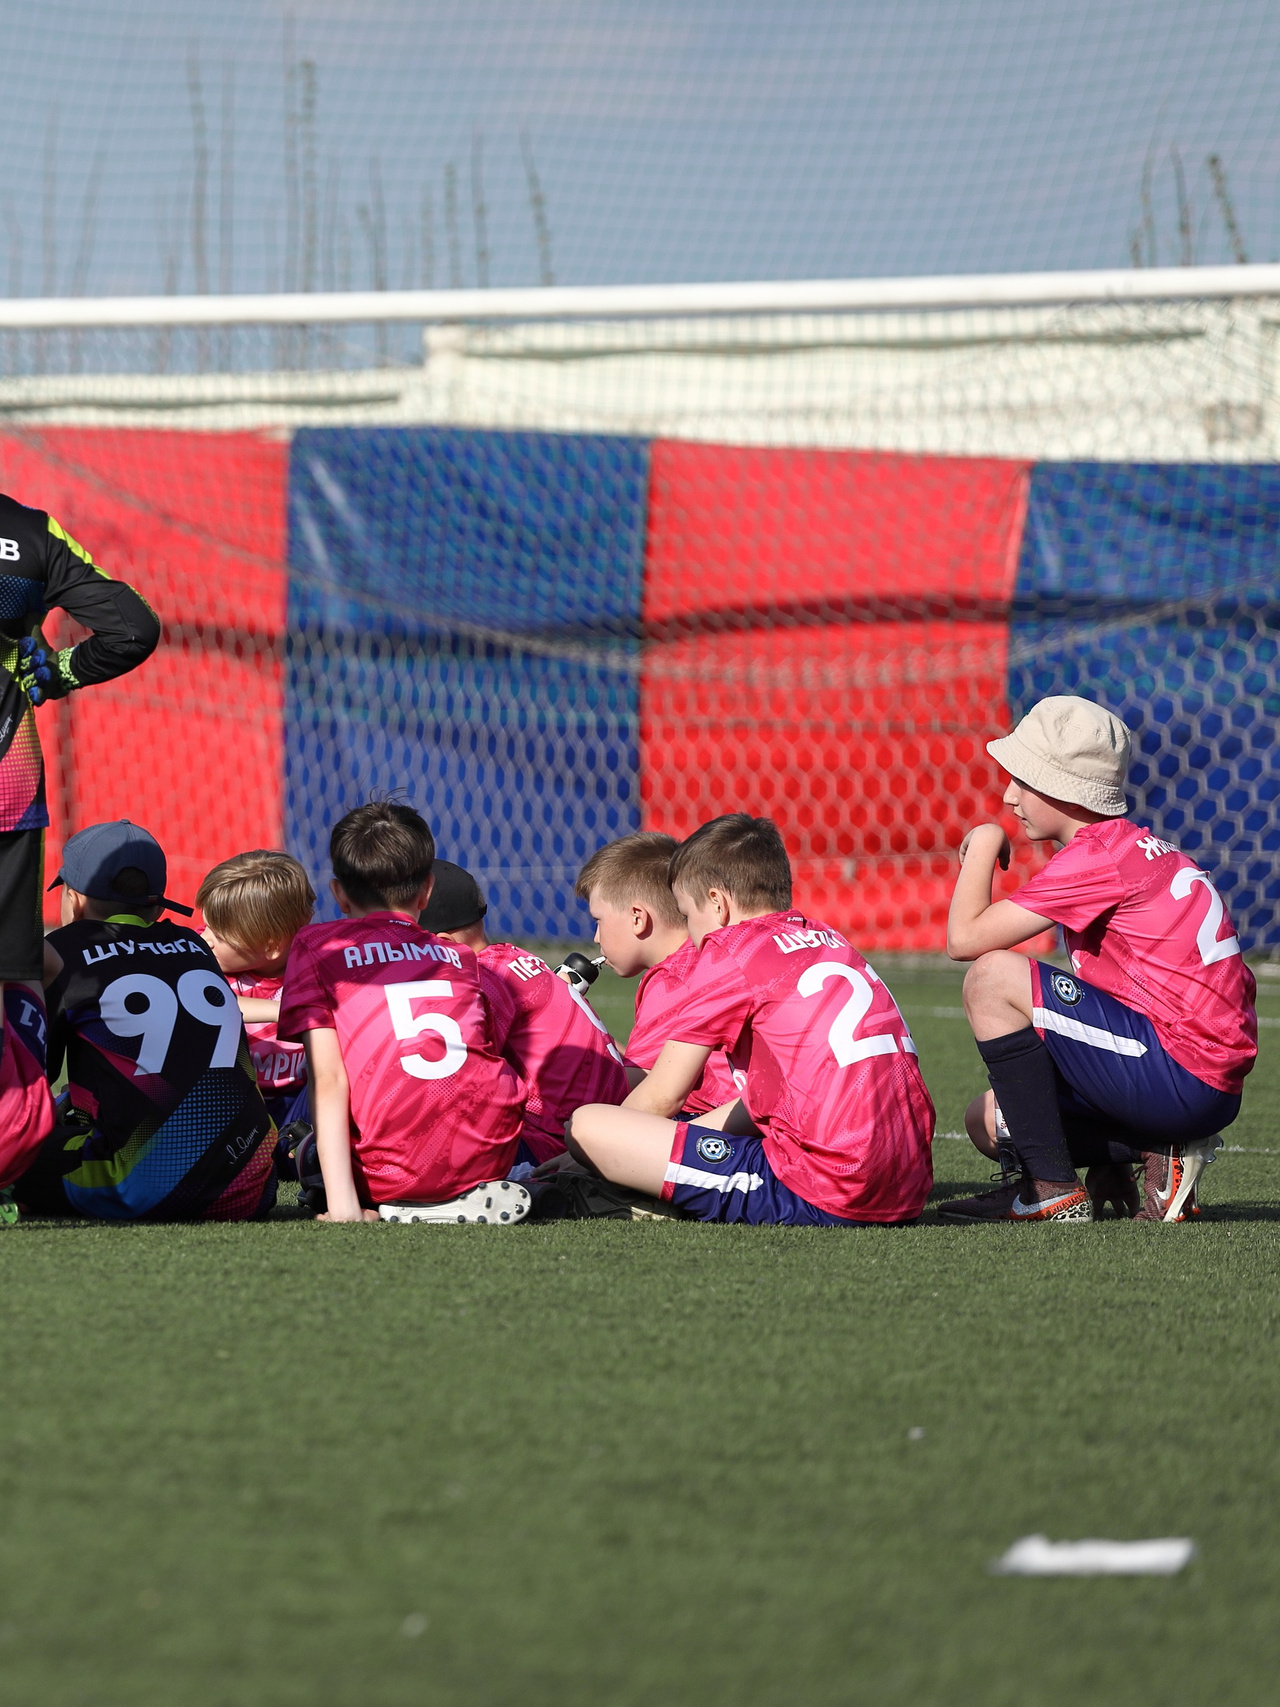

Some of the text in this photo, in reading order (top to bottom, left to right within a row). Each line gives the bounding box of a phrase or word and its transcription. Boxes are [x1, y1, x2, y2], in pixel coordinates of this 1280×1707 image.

[343, 942, 463, 970] АЛЫМОВ
[98, 968, 244, 1077] 99
[383, 979, 469, 1081] 5
